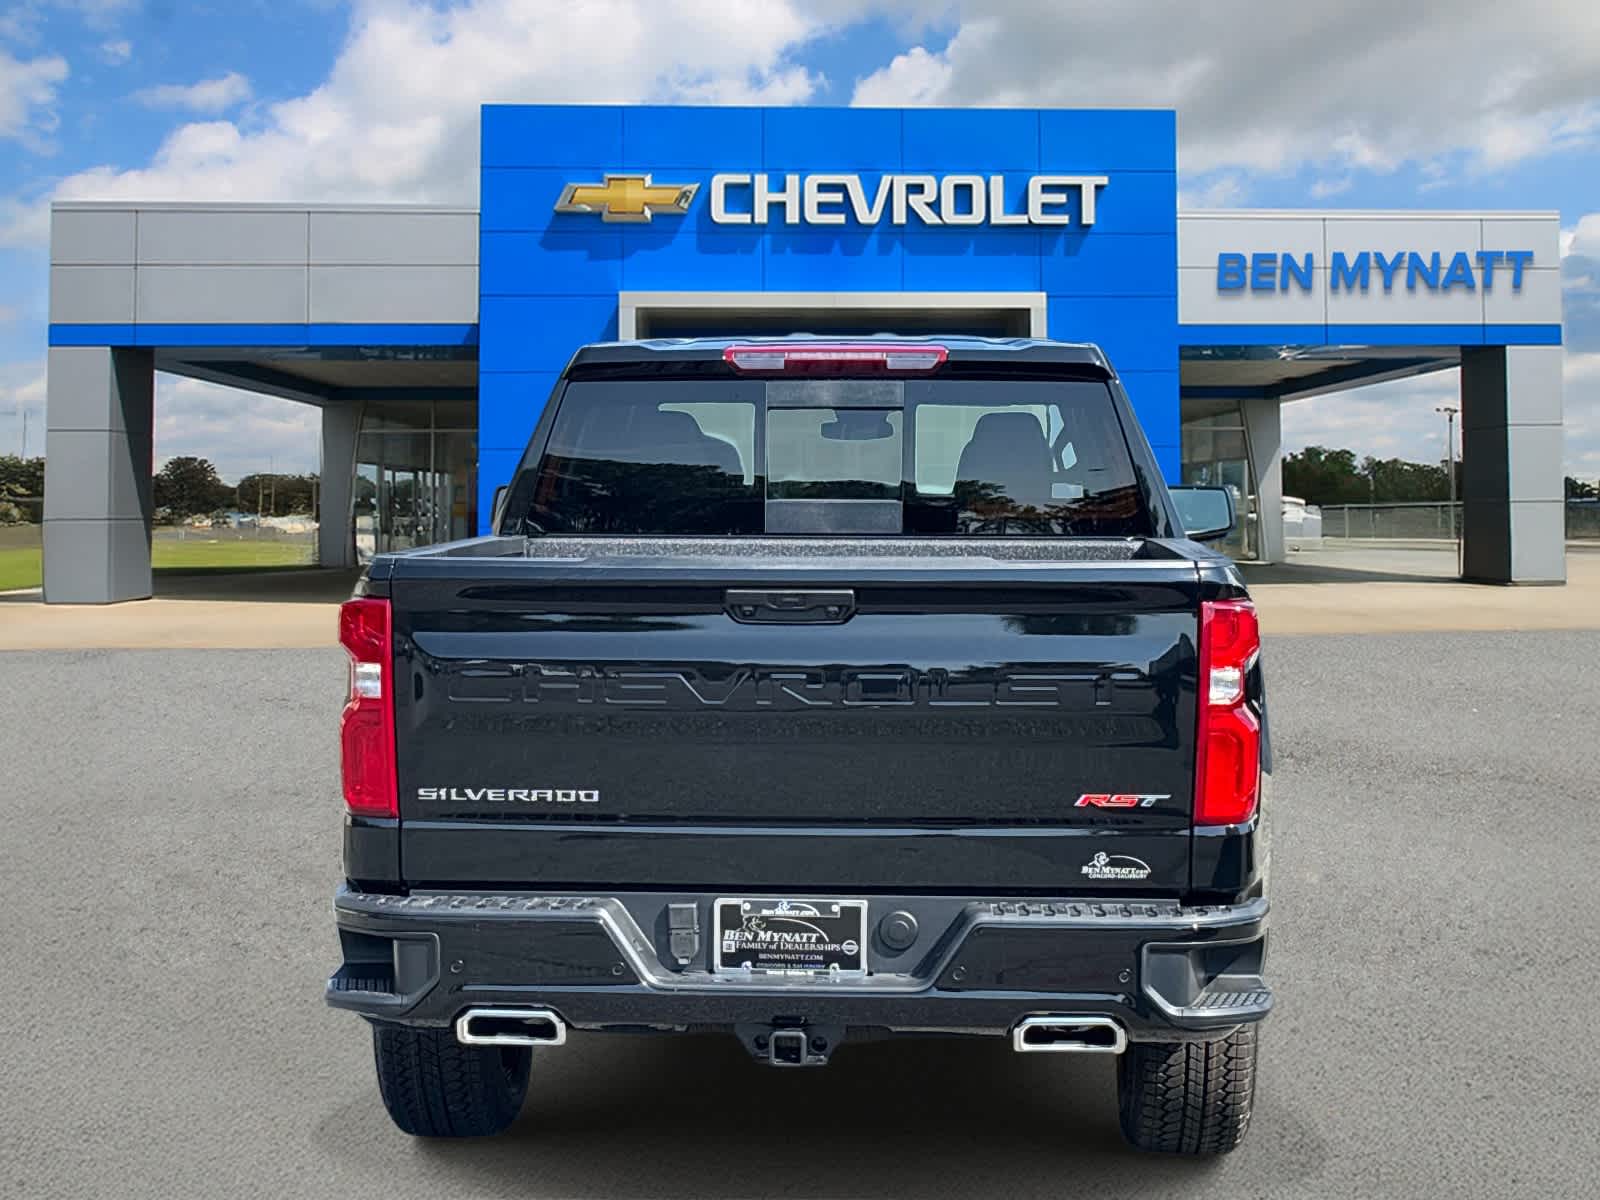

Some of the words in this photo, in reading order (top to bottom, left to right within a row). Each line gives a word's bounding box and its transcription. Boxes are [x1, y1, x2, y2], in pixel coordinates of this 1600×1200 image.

[710, 174, 1109, 225] CHEVROLET
[1217, 252, 1313, 291] BEN
[1330, 250, 1534, 291] MYNATT
[417, 787, 600, 803] SILVERADO
[1073, 793, 1172, 807] RST
[723, 930, 754, 940] BEN
[756, 930, 820, 943] MYNATT
[736, 941, 768, 950] FAMILY
[780, 941, 841, 952] DEALERSHIPS
[758, 953, 824, 961] BENMYNATT.COM
